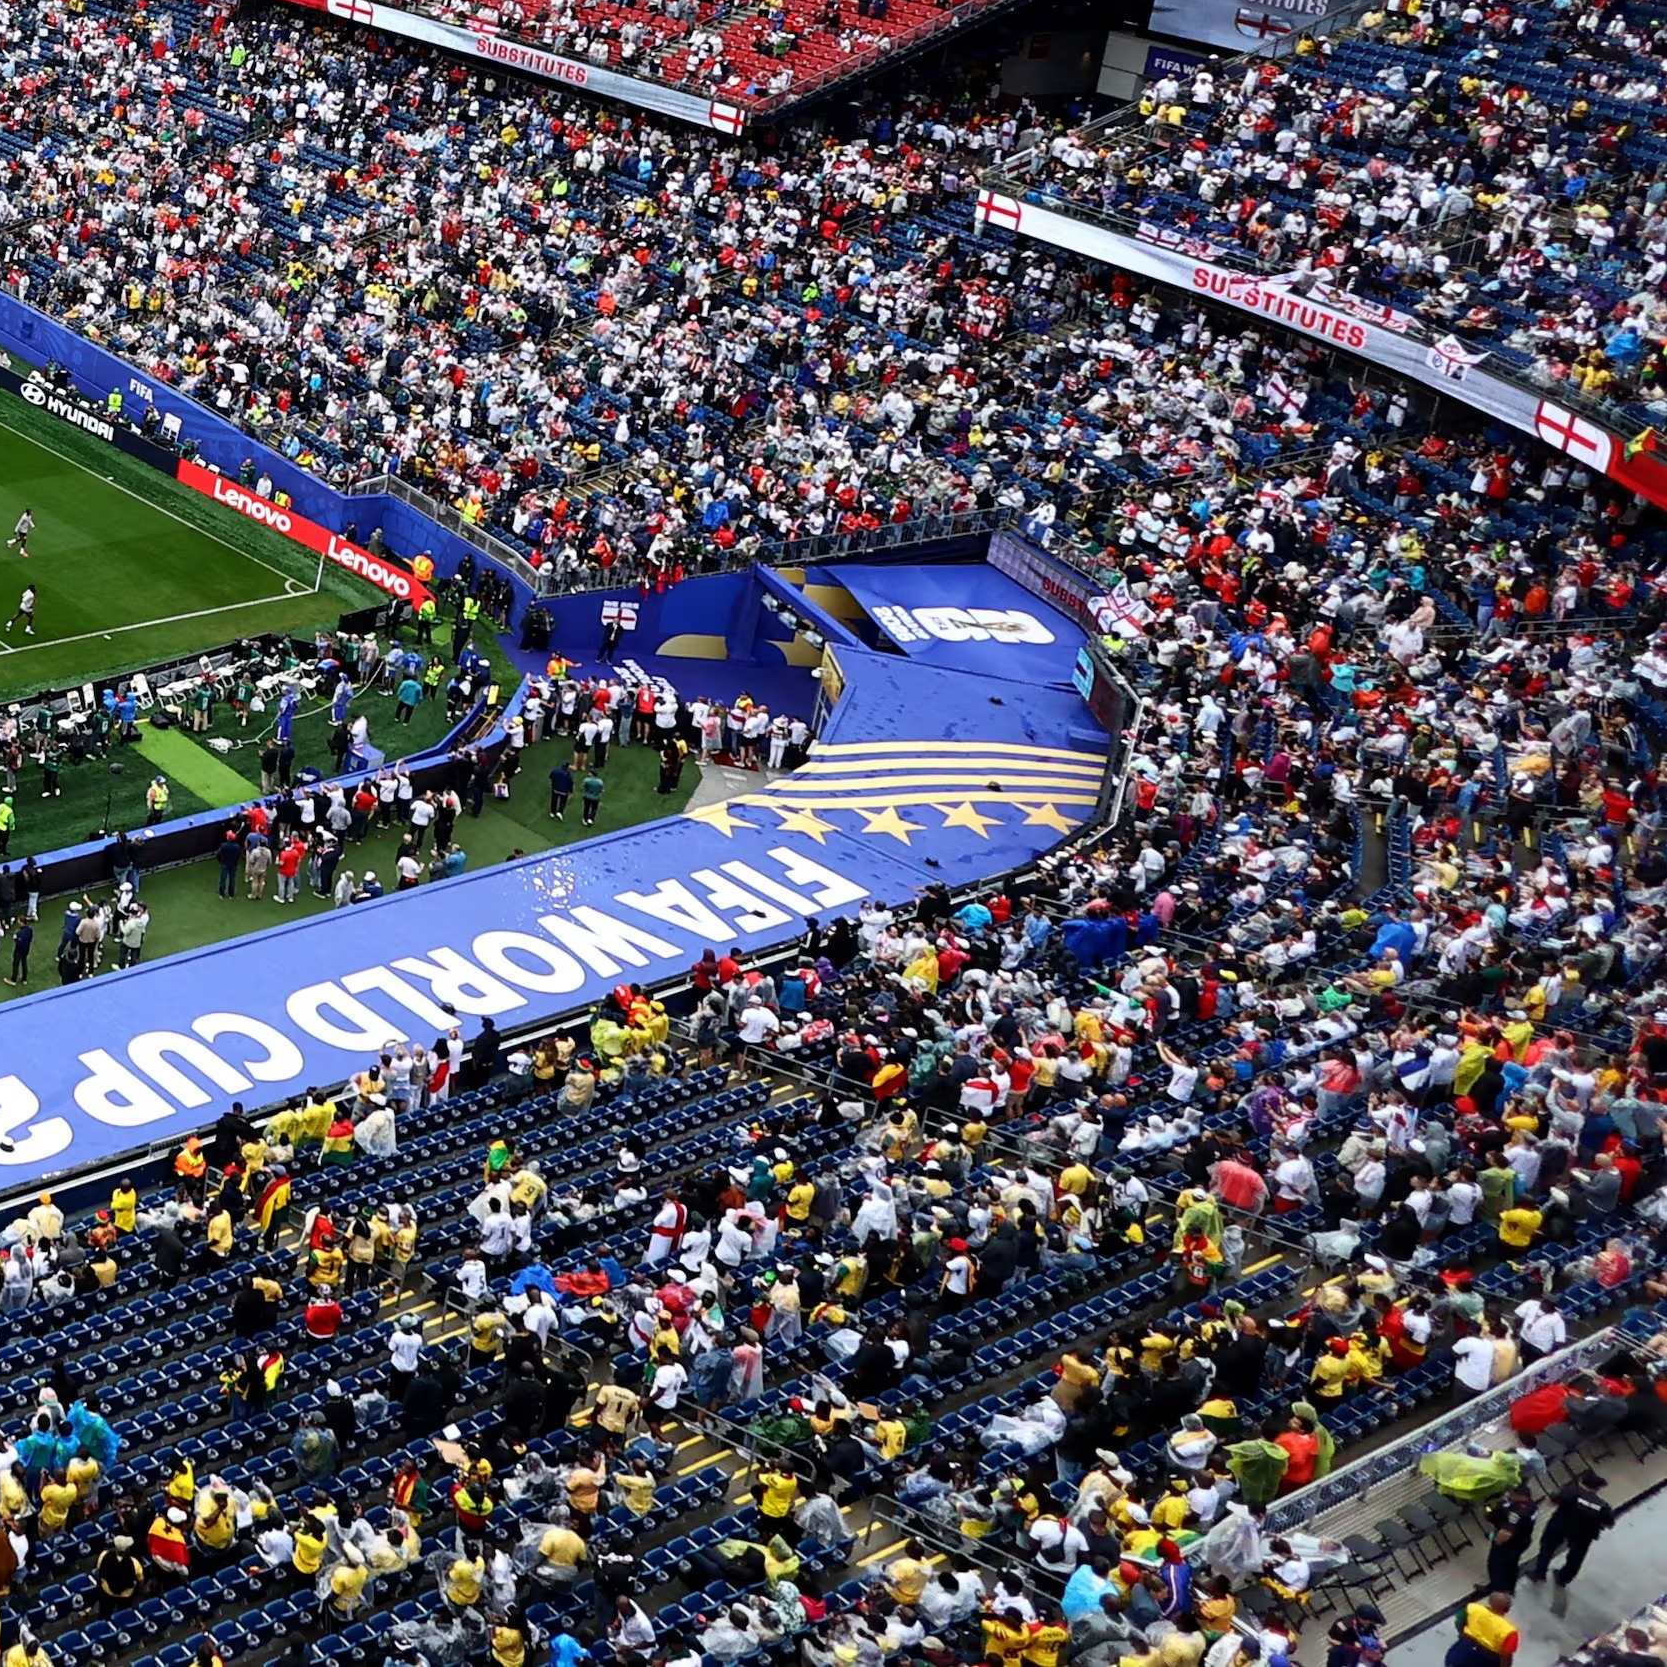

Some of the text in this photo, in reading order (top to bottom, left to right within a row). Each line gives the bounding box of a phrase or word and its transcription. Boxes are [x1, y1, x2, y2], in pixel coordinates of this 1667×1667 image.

[477, 37, 586, 83] SUBSTITUTES
[1154, 57, 1181, 74] FIFA
[1193, 267, 1366, 349] SUSTITUTES
[47, 394, 115, 441] HYUNDAI
[129, 377, 154, 404] FIFA
[213, 477, 292, 534] Lenovo
[327, 535, 410, 597] Lenovo
[613, 846, 870, 944] FIFA
[285, 900, 684, 1056] WORLD
[71, 1012, 303, 1129] CUP
